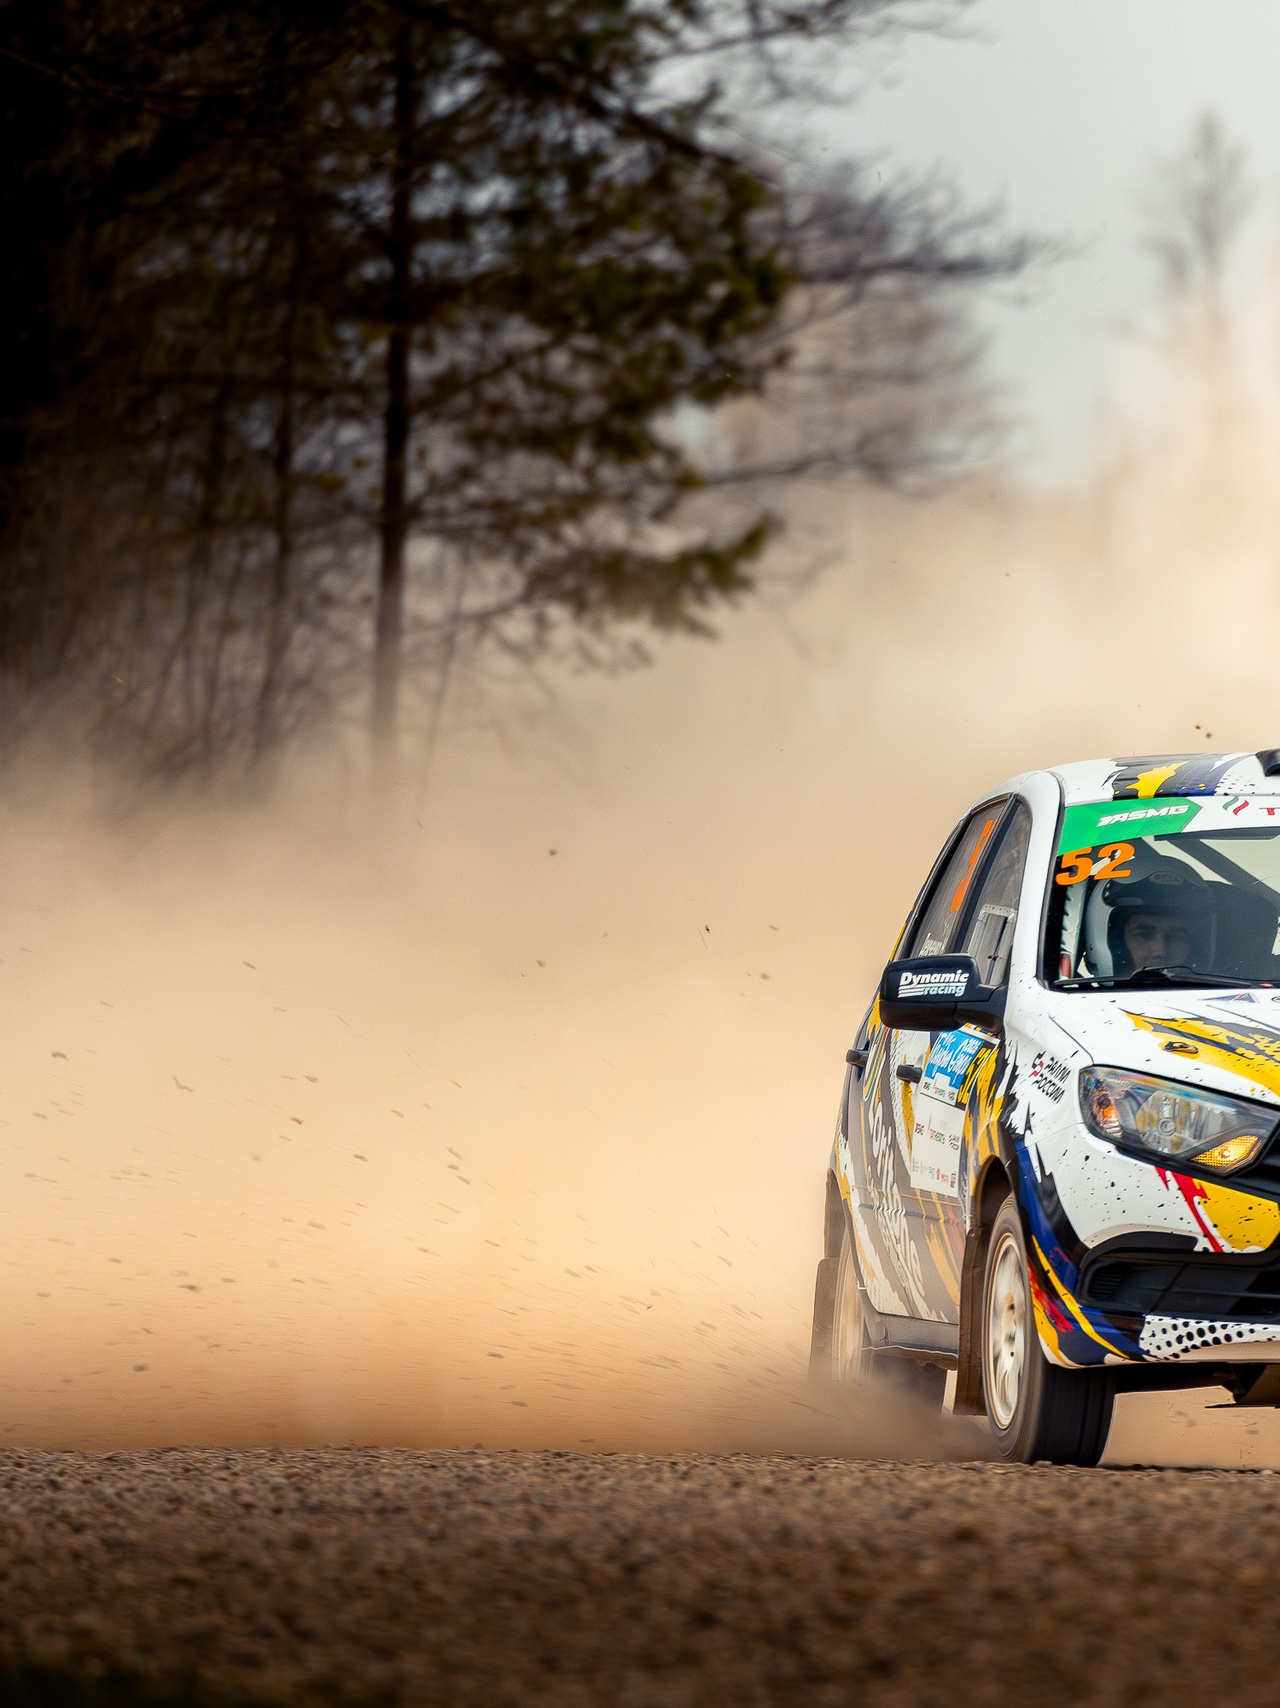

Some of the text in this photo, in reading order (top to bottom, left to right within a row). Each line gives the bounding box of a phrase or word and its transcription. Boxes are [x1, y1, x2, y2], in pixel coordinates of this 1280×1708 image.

[1055, 842, 1136, 886] 52
[899, 969, 970, 988] Dynamic
[923, 985, 966, 997] racing
[1043, 1056, 1071, 1084] РАЛЛИ
[1030, 1073, 1066, 1104] РОССИИ
